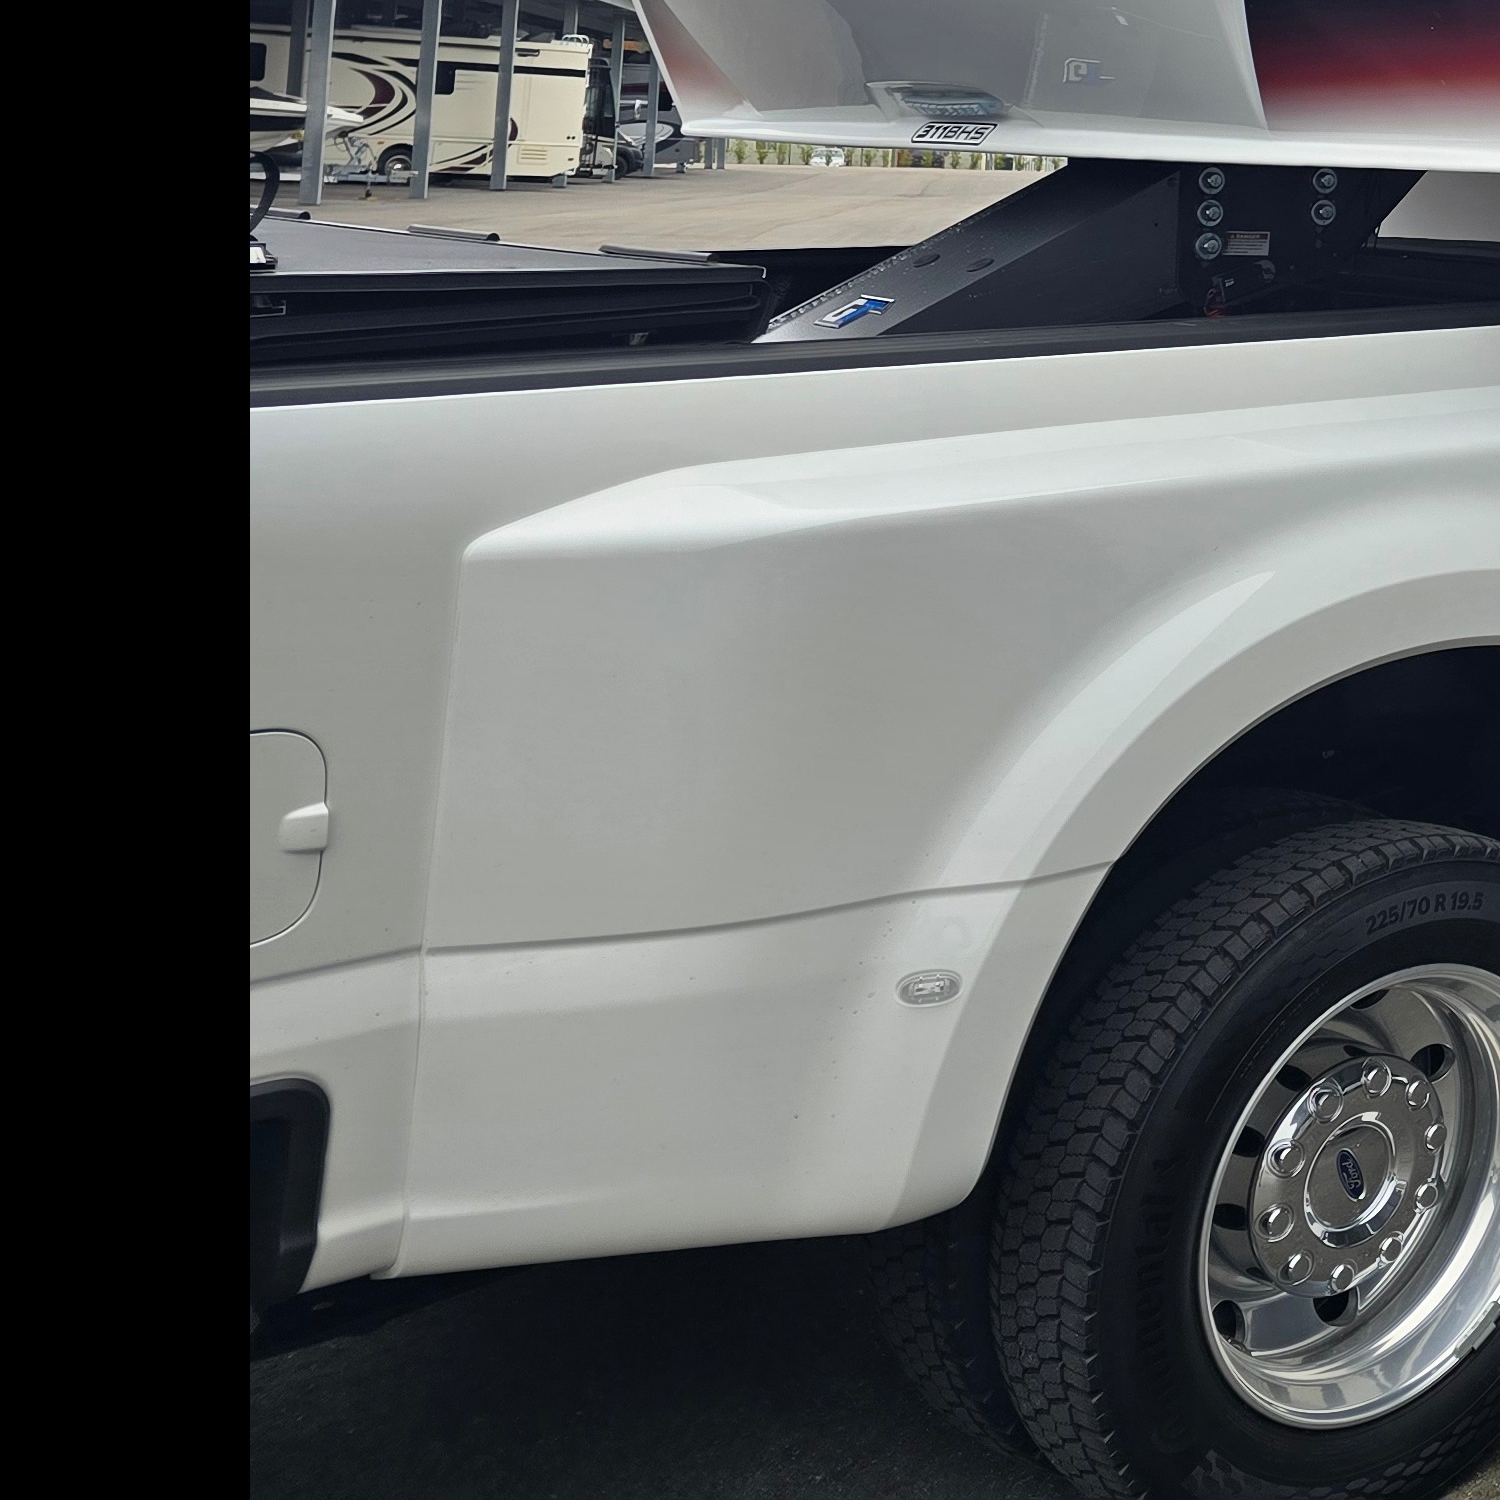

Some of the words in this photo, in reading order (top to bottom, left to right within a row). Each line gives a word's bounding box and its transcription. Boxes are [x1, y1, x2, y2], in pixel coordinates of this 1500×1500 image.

[915, 124, 991, 141] 311BHS
[1365, 895, 1431, 935] 225/70
[1434, 893, 1447, 912] R
[1450, 891, 1484, 911] 19.5
[1342, 1158, 1361, 1190] Ford
